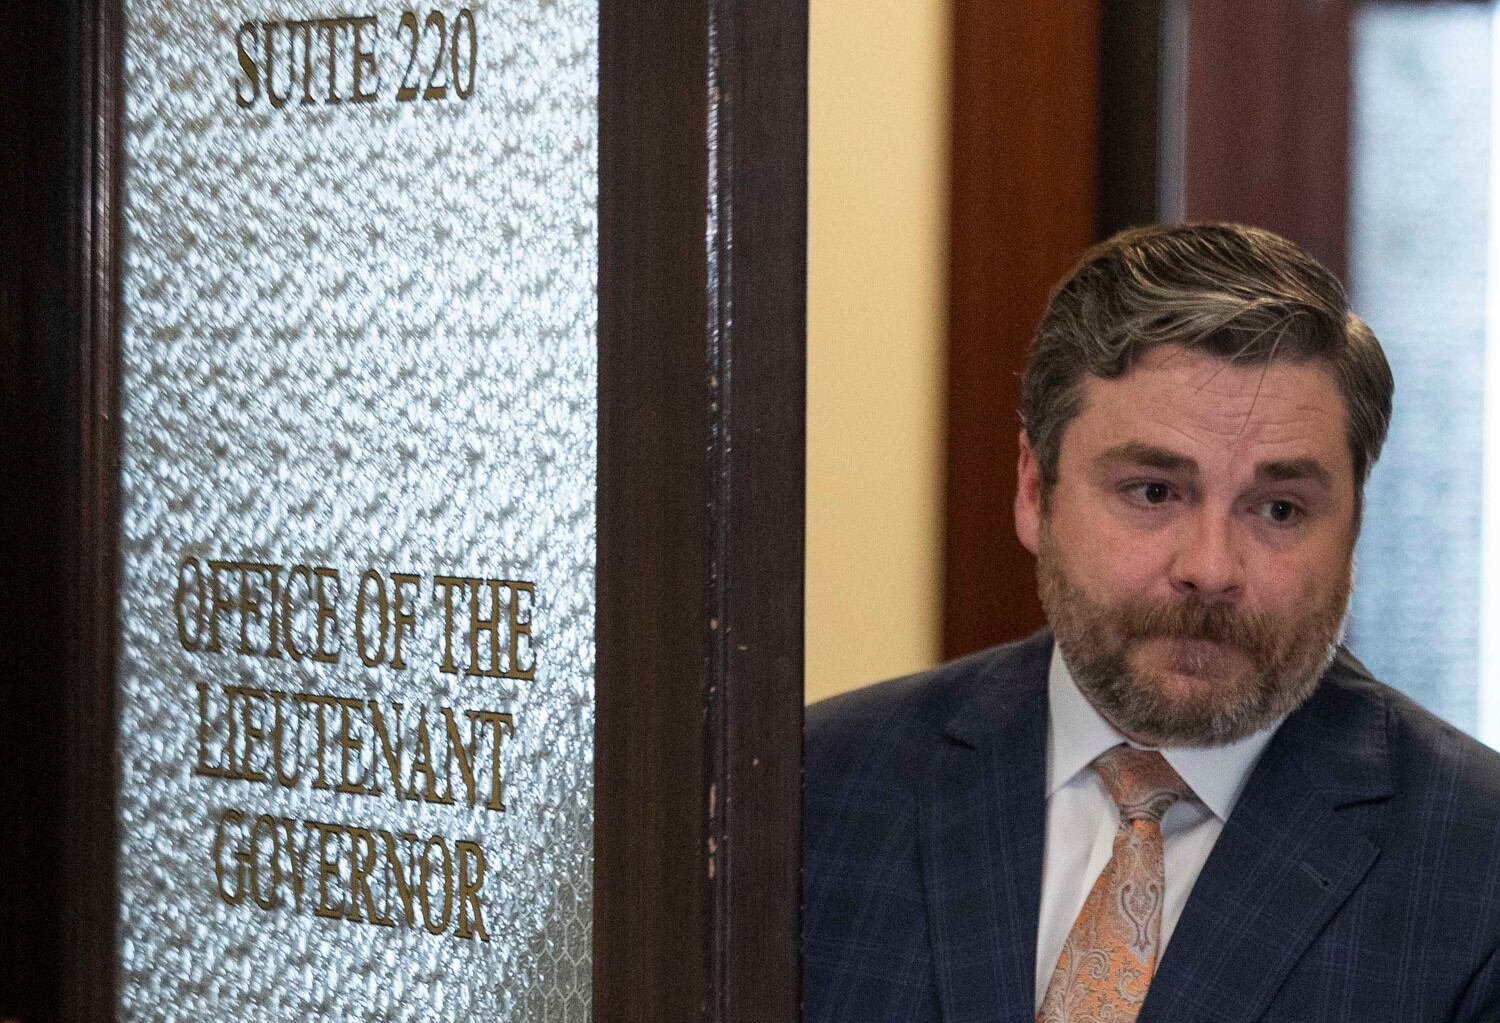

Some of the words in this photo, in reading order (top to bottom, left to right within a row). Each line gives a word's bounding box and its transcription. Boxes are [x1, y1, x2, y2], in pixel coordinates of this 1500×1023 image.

[235, 16, 380, 108] SUITE
[396, 9, 477, 102] 220
[176, 556, 340, 663] OFFICE
[355, 569, 420, 670] OF
[433, 575, 536, 681] THE
[195, 684, 514, 812] LIEUTENANT
[215, 810, 490, 942] GOVERNOR
